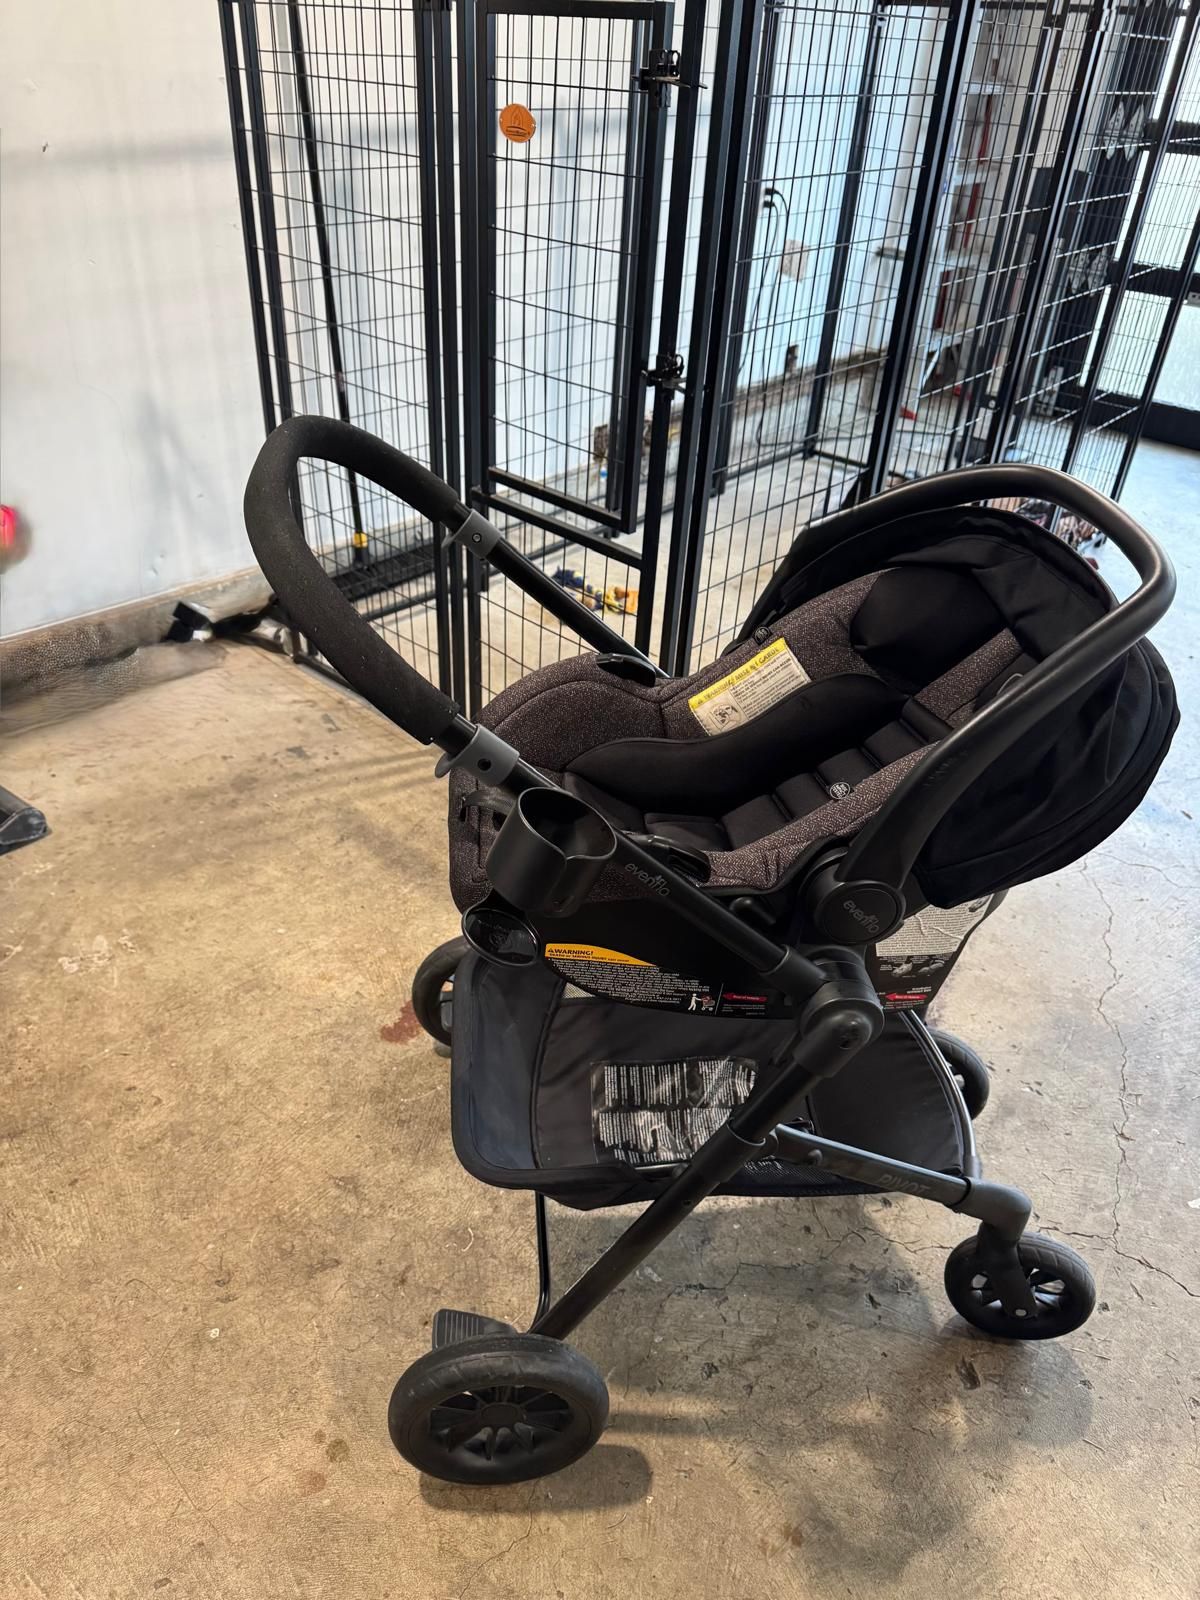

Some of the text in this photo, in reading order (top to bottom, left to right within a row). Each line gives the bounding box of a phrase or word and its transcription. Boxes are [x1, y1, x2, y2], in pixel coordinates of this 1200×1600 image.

[624, 863, 670, 896] evenflo
[843, 900, 879, 933] evenflo
[554, 948, 594, 956] WARNING!
[876, 1174, 931, 1194] PIVOT
